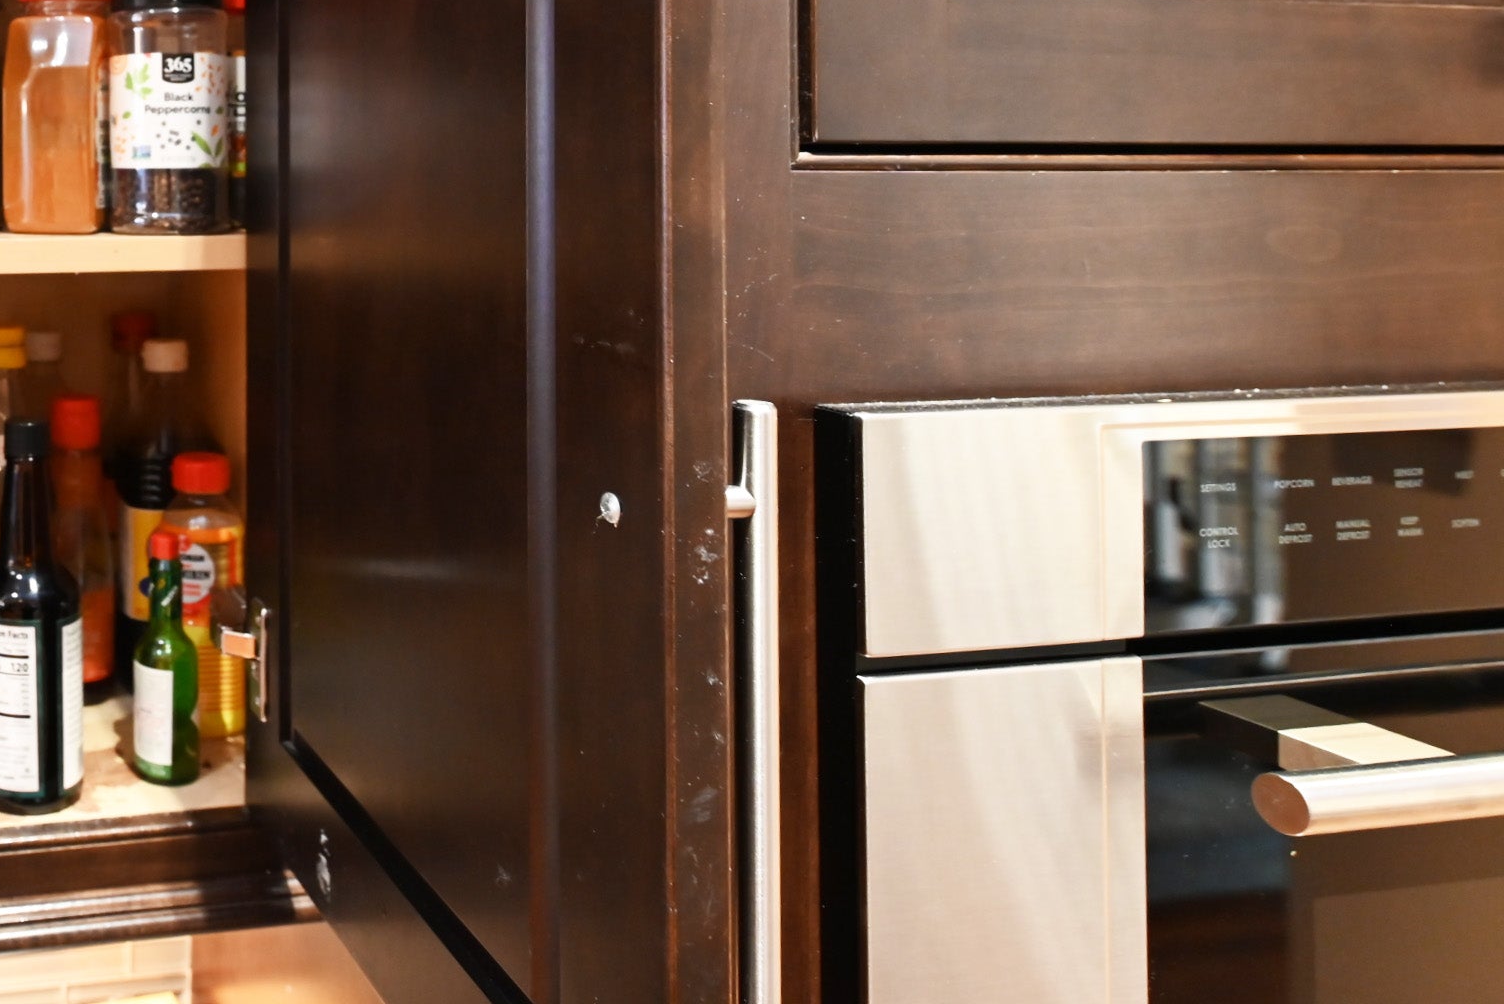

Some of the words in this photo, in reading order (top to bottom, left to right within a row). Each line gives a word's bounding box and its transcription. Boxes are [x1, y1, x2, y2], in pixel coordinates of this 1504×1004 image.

[164, 56, 193, 74] 365
[164, 92, 193, 102] Black
[144, 104, 211, 115] Peppercorns
[1200, 483, 1237, 493] SETTINGS
[1274, 479, 1315, 489] POPCORN
[1199, 527, 1239, 537] CONTROL
[1284, 522, 1307, 532] AUTO
[1278, 533, 1313, 544] DEFROST
[1336, 530, 1371, 541] DEFROST
[1207, 539, 1231, 549] LOCK
[11, 663, 29, 673] 120
